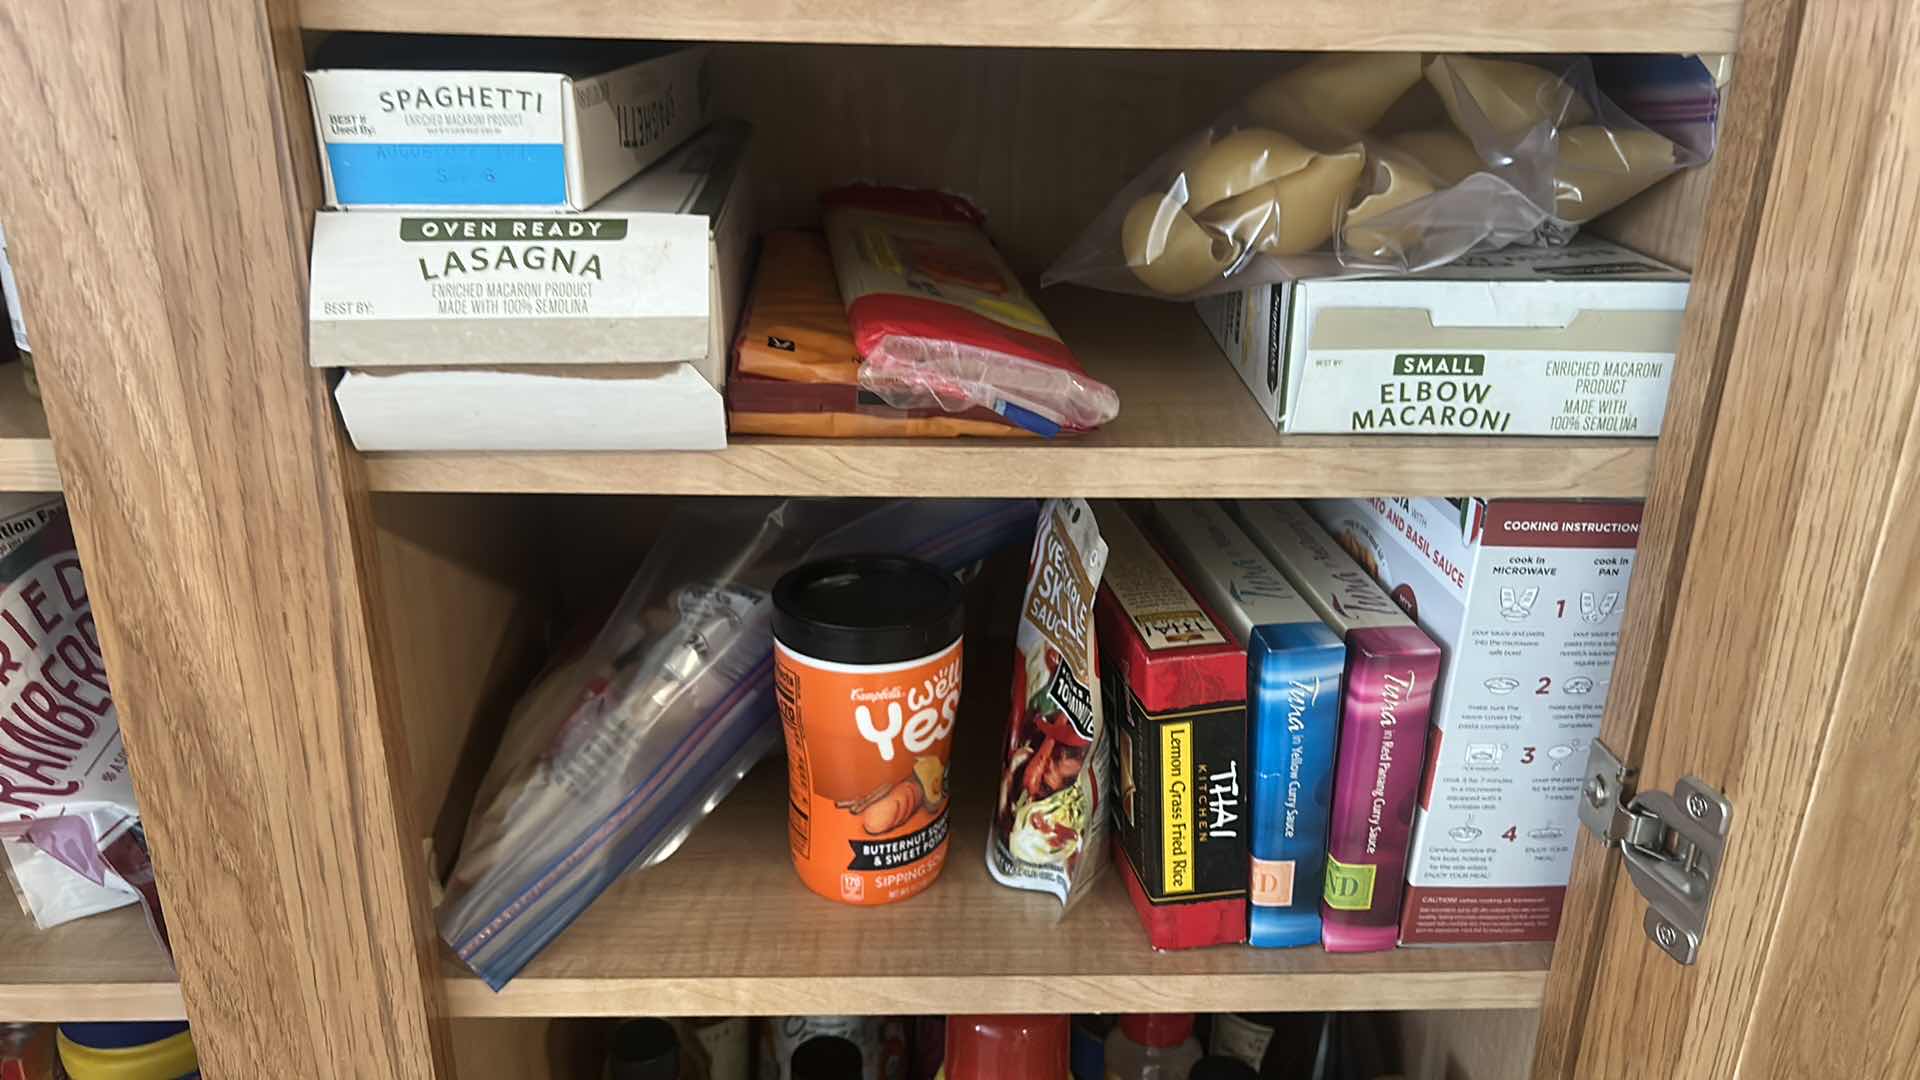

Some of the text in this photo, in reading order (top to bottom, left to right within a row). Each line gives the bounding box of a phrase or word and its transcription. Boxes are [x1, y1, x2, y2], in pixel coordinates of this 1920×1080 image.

[379, 86, 543, 113] SPAGHETTI
[421, 221, 603, 238] OVEN READY
[418, 245, 604, 281] LASAGNA
[431, 281, 593, 299] ENRICHED MACARONI PRODUCT
[323, 302, 375, 315] BEST BY:
[437, 299, 589, 315] MADE WITH 100% SEMOLINA
[1403, 357, 1474, 374] SMALL
[1545, 361, 1664, 378] ENRICHED MACARONI
[1380, 381, 1492, 405] ELBOW
[1575, 379, 1626, 395] PRODUCT
[1563, 400, 1627, 415] MADE WITH
[1351, 405, 1511, 432] MACARONI
[1550, 416, 1638, 432] 100% SEMOLINA
[0, 516, 36, 541] tion
[1503, 520, 1559, 533] COOKING
[1386, 508, 1406, 532] AND
[1405, 525, 1431, 559] BASIL
[1432, 549, 1465, 589] SAUCE
[1509, 555, 1546, 566] cook in
[1593, 556, 1616, 566] cook
[1492, 566, 1557, 577] MICROWAVE
[1599, 567, 1620, 577] PAN
[1556, 599, 1566, 619] 1
[1535, 676, 1552, 695] 2
[1380, 670, 1416, 727] Tuna
[1384, 729, 1394, 739] in
[1284, 675, 1320, 838] Tuna in Yellow Curry Sauce
[1379, 741, 1393, 760] Red
[1520, 746, 1536, 764] 3
[1169, 729, 1187, 887] Lemon Grass Fried Rice
[1198, 763, 1208, 844] KITCHEN
[1209, 760, 1239, 838] THAI
[1368, 798, 1386, 826] Curry
[1366, 826, 1381, 855] Sauce
[1501, 826, 1518, 843] 4
[863, 833, 926, 856] BUTTERNUT
[874, 856, 882, 867] &
[885, 847, 921, 866] SWEET
[874, 864, 928, 889] SIPPING
